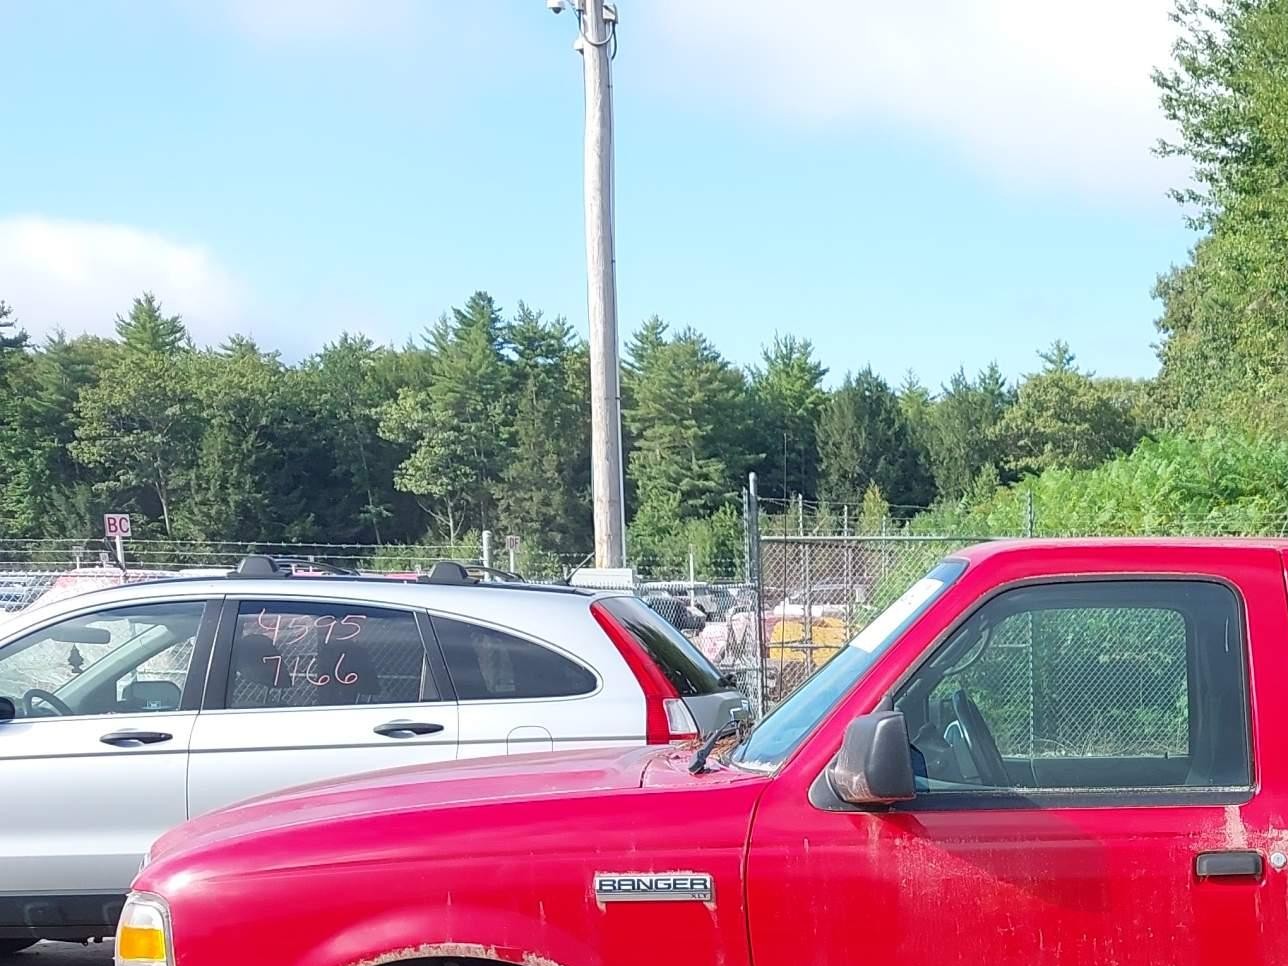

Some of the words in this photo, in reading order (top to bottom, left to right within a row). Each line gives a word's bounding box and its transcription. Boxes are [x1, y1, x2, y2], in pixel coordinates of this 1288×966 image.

[107, 516, 130, 533] BC
[258, 607, 367, 646] 4595
[262, 653, 359, 686] 7166
[598, 878, 709, 892] RANGER
